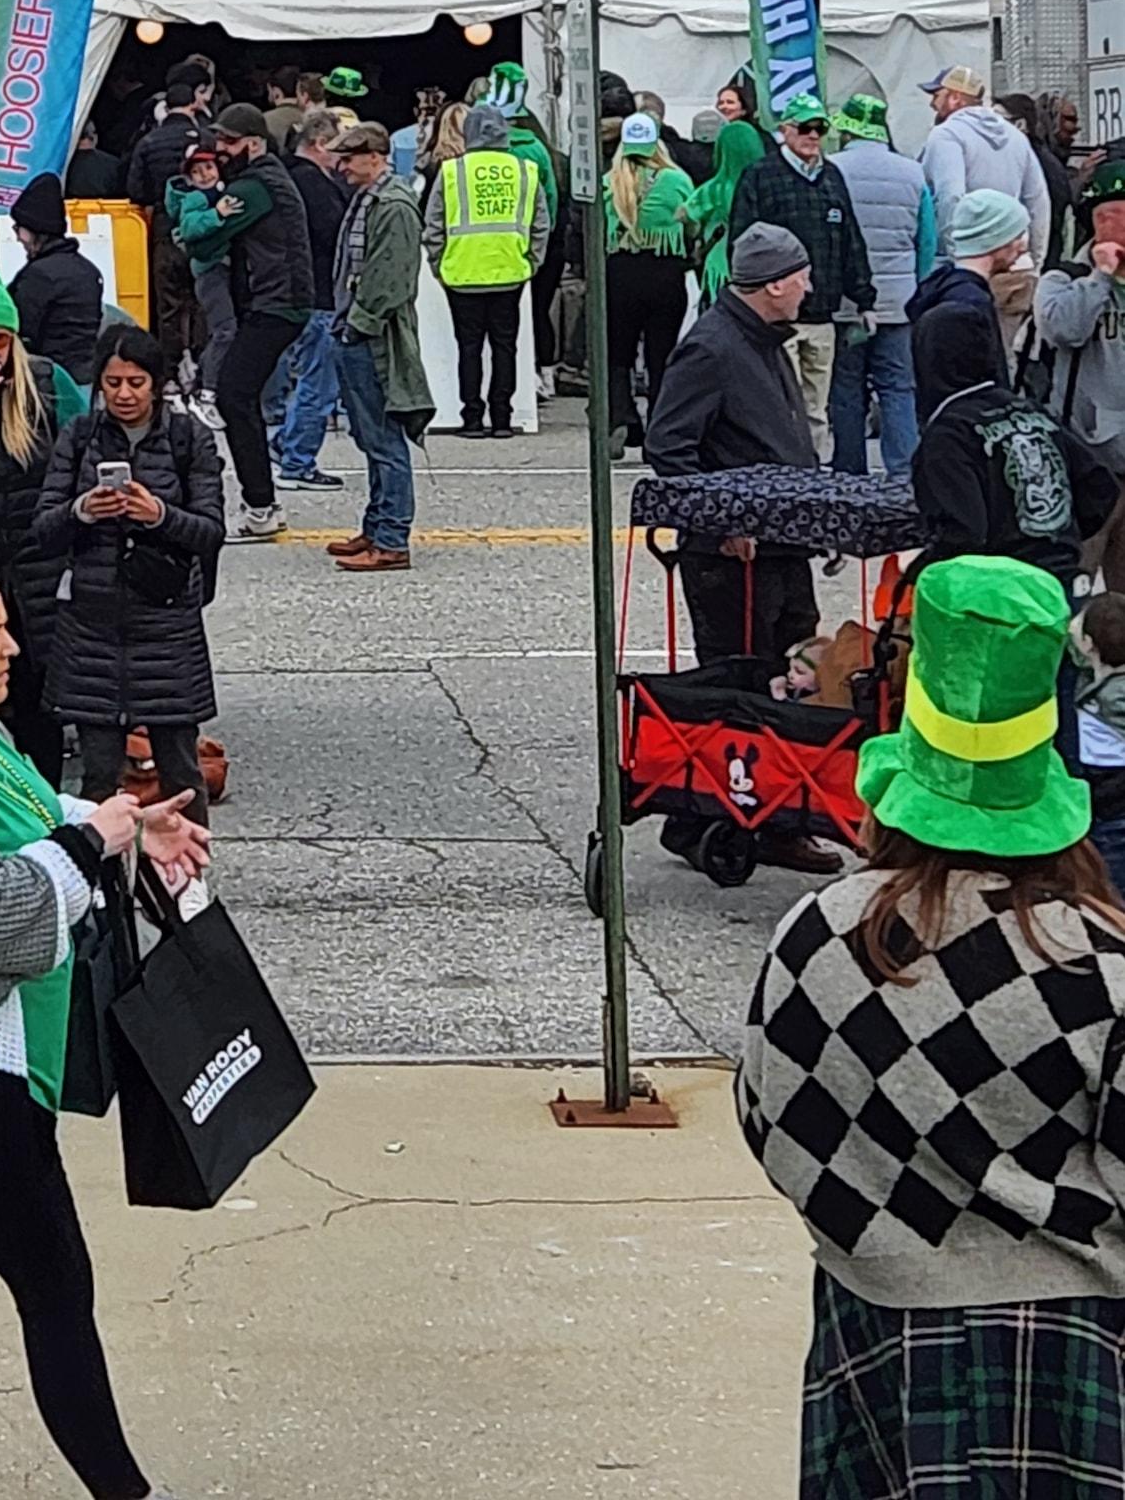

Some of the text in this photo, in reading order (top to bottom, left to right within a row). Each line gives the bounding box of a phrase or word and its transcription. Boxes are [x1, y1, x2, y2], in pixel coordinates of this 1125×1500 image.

[475, 165, 514, 181] CSC
[475, 183, 516, 199] SECURITY
[476, 199, 515, 217] STAFF
[182, 1027, 252, 1109] VAN ROOY
